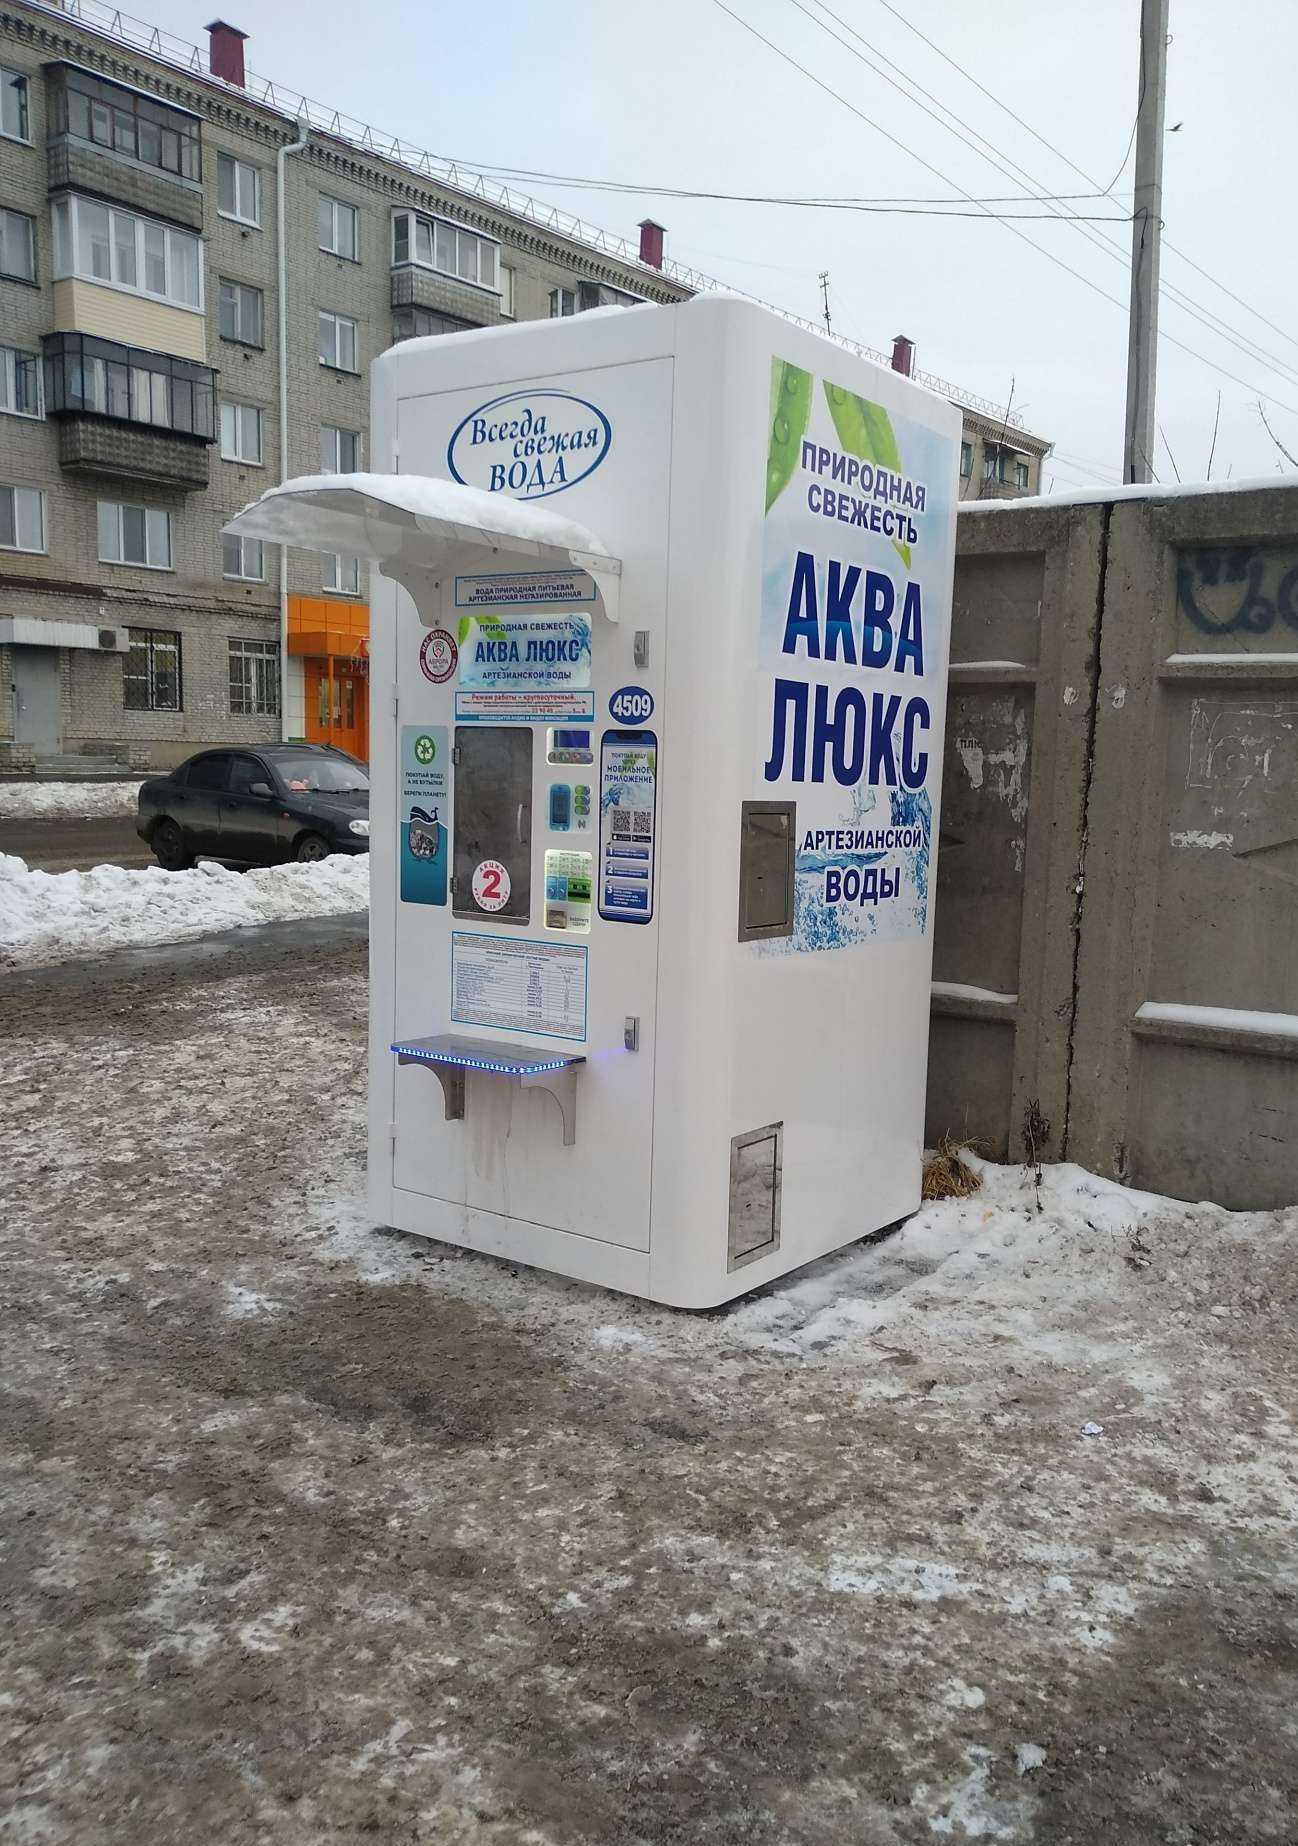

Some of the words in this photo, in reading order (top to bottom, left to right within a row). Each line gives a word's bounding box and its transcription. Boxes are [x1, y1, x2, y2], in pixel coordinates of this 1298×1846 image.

[470, 408, 547, 446] Всегда
[513, 427, 599, 459] свежая
[488, 456, 568, 493] ВОДА
[801, 440, 927, 513] ПРИРОДНАЯ
[806, 483, 919, 544] СВЕЖЕСТЬ
[475, 587, 494, 595] ВОДА
[494, 585, 537, 594] ПРИРОДНАЯ
[479, 623, 528, 632] ПРИРОДНАЯ
[530, 621, 575, 631] СВЕЖЕСТЬ
[781, 551, 924, 677] АКВА
[475, 640, 520, 663] АКВА
[525, 638, 580, 663] ЛЮКС
[547, 671, 572, 679] ВОДЫ
[612, 694, 652, 717] 4509
[764, 678, 930, 789] ЛЮКС
[604, 774, 654, 784] ПРИЛОЖЕНИЕ
[607, 765, 651, 774] МОБИЛЬНОЕ
[803, 824, 922, 851] АРТЕЗИАНСКОЙ
[608, 847, 613, 855] 1
[607, 866, 613, 874] 2
[482, 870, 501, 899] 2
[607, 885, 613, 894] 3
[825, 866, 901, 905] ВОДЫ
